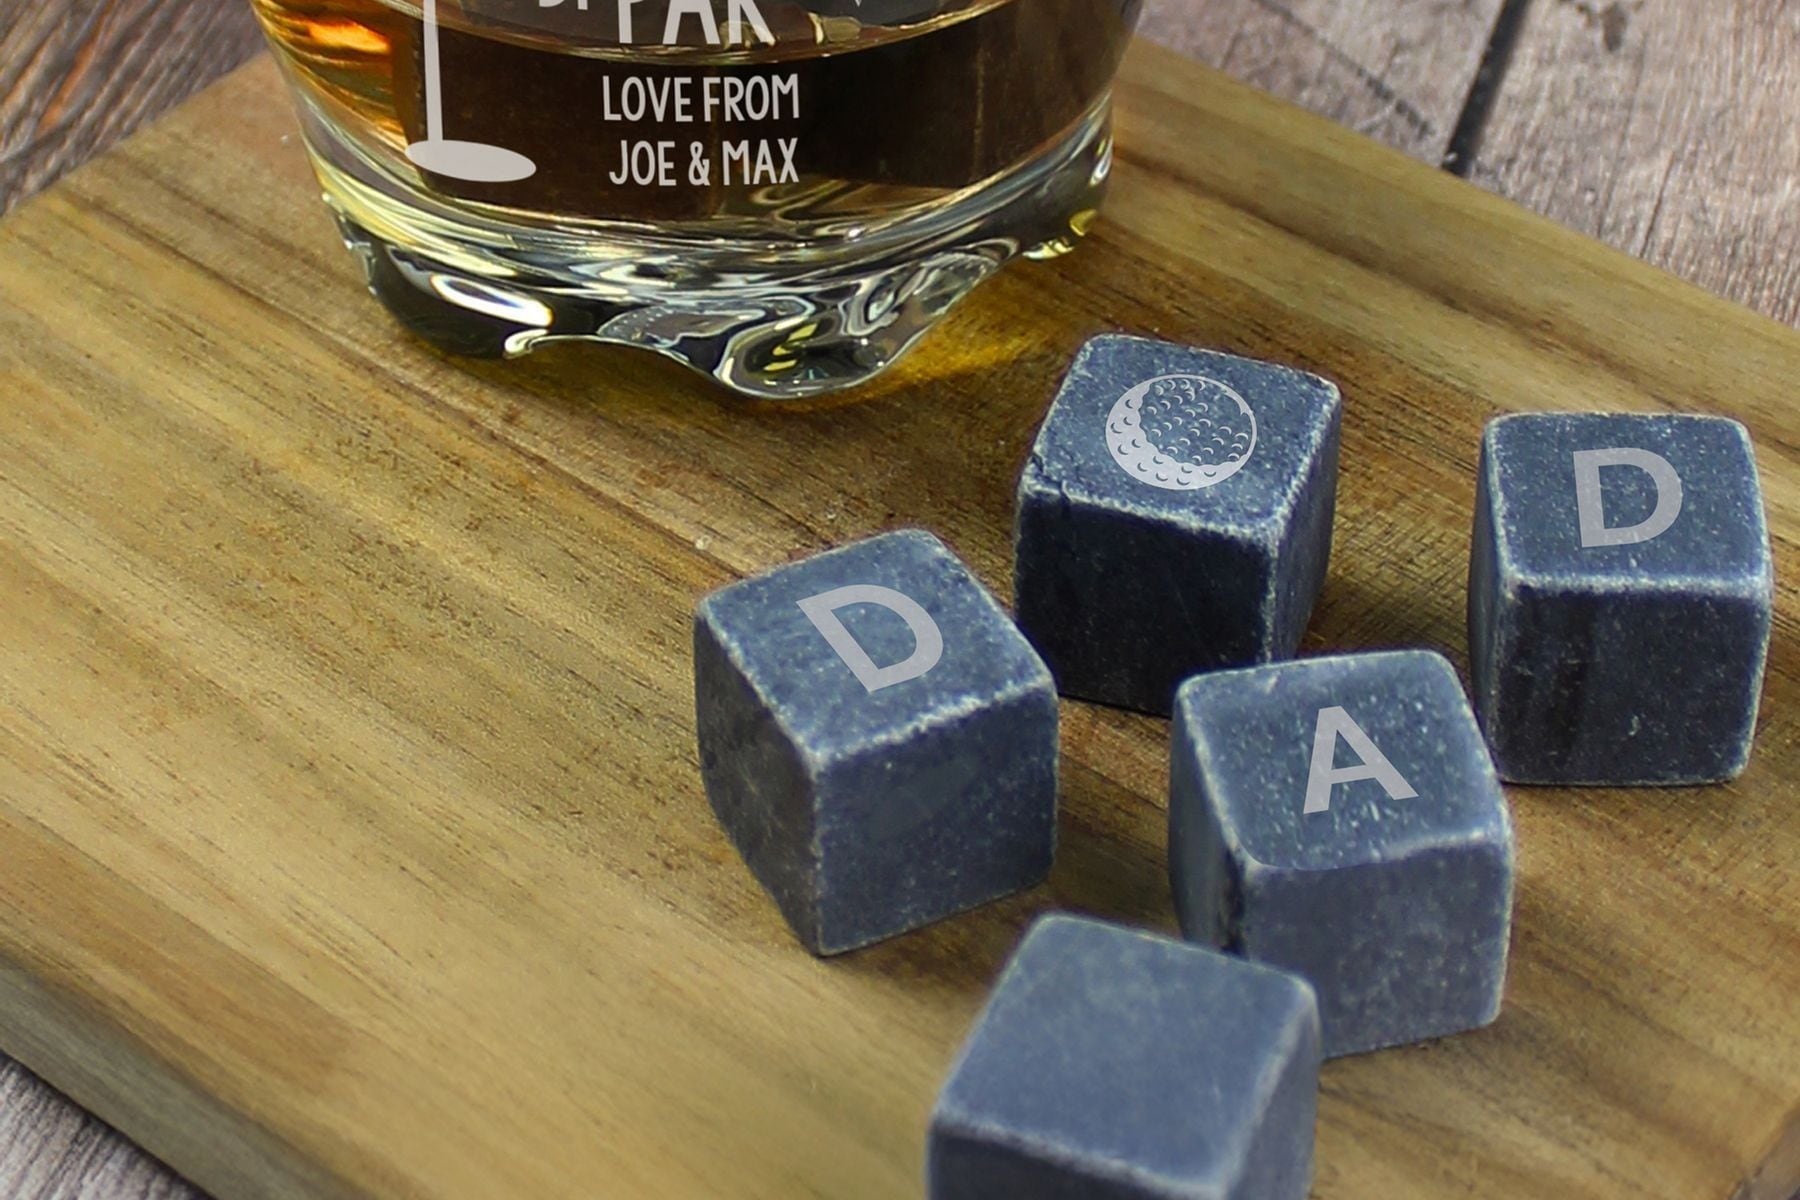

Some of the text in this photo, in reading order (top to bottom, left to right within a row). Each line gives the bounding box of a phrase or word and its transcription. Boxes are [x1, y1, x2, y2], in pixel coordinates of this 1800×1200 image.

[602, 74, 799, 122] LOVE FROM
[609, 138, 799, 186] JOE & MAX
[1573, 447, 1684, 548] D
[796, 584, 944, 693] D
[1303, 705, 1419, 815] A
